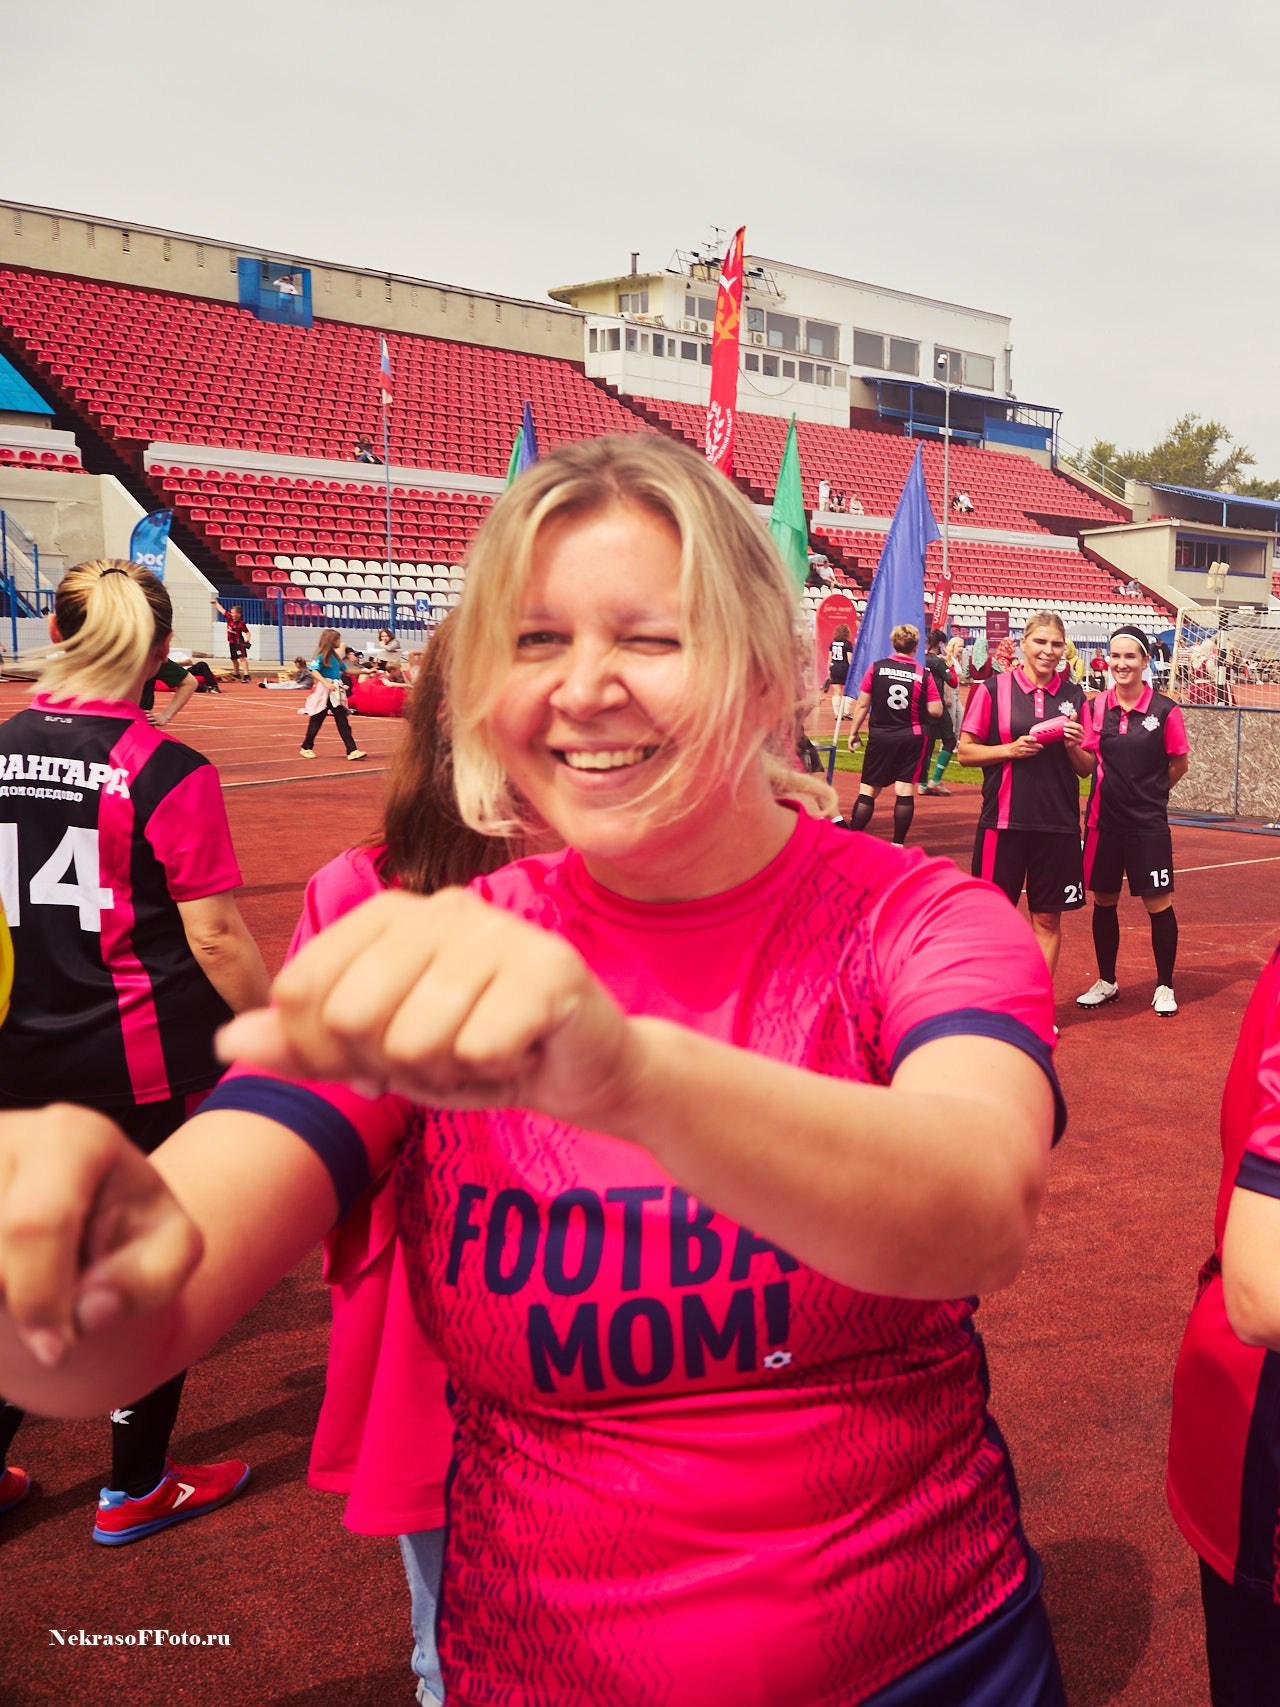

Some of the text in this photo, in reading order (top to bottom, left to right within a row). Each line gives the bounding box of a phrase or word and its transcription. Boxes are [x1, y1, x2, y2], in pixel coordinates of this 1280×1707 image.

[886, 684, 909, 710] 8
[44, 715, 73, 725] surus
[0, 822, 114, 932] 14
[1150, 868, 1170, 888] 15
[527, 1280, 792, 1393] MOM!
